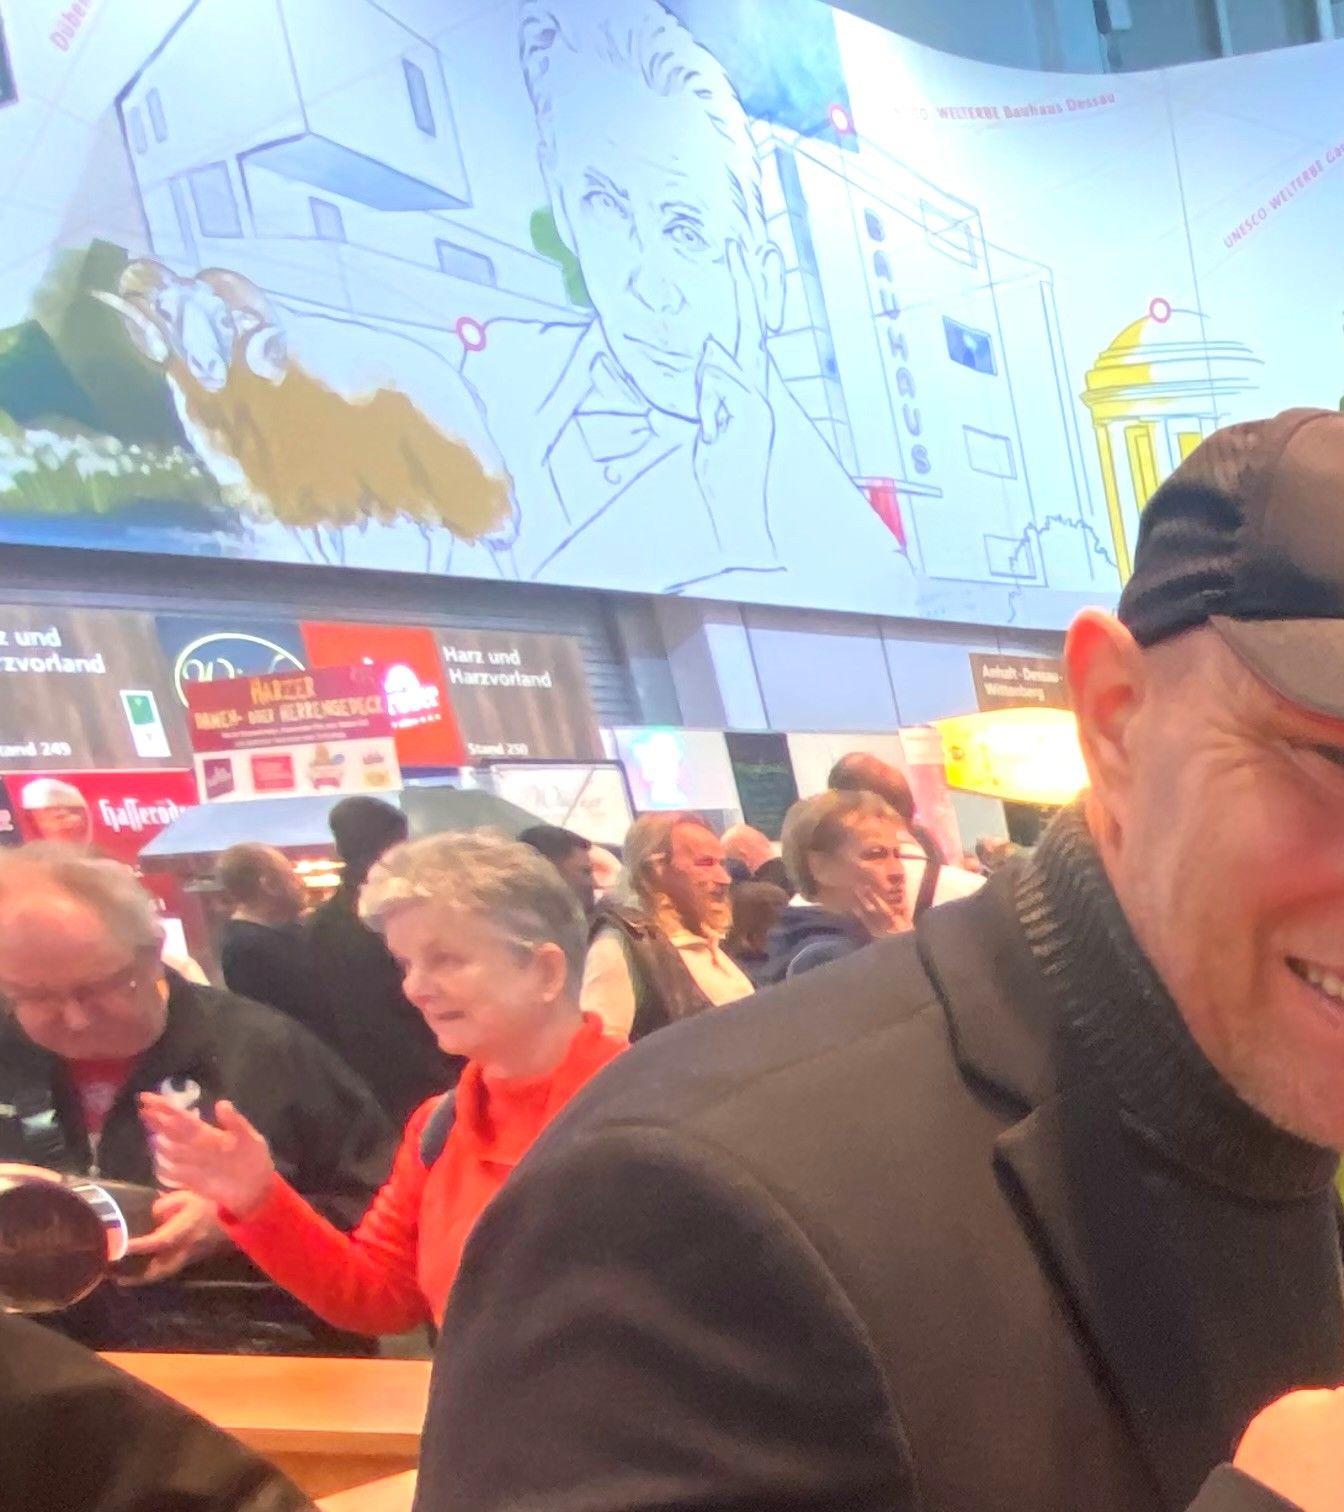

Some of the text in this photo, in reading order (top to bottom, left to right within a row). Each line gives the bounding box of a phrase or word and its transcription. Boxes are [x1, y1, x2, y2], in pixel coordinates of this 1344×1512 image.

[1002, 103, 1063, 119] Bauhaus
[1065, 91, 1116, 111] Dessau
[863, 207, 931, 475] BAUHAUS
[15, 627, 62, 648] und
[442, 646, 522, 666] Harz und
[449, 668, 552, 688] Harzvorland
[467, 742, 505, 756] Stand
